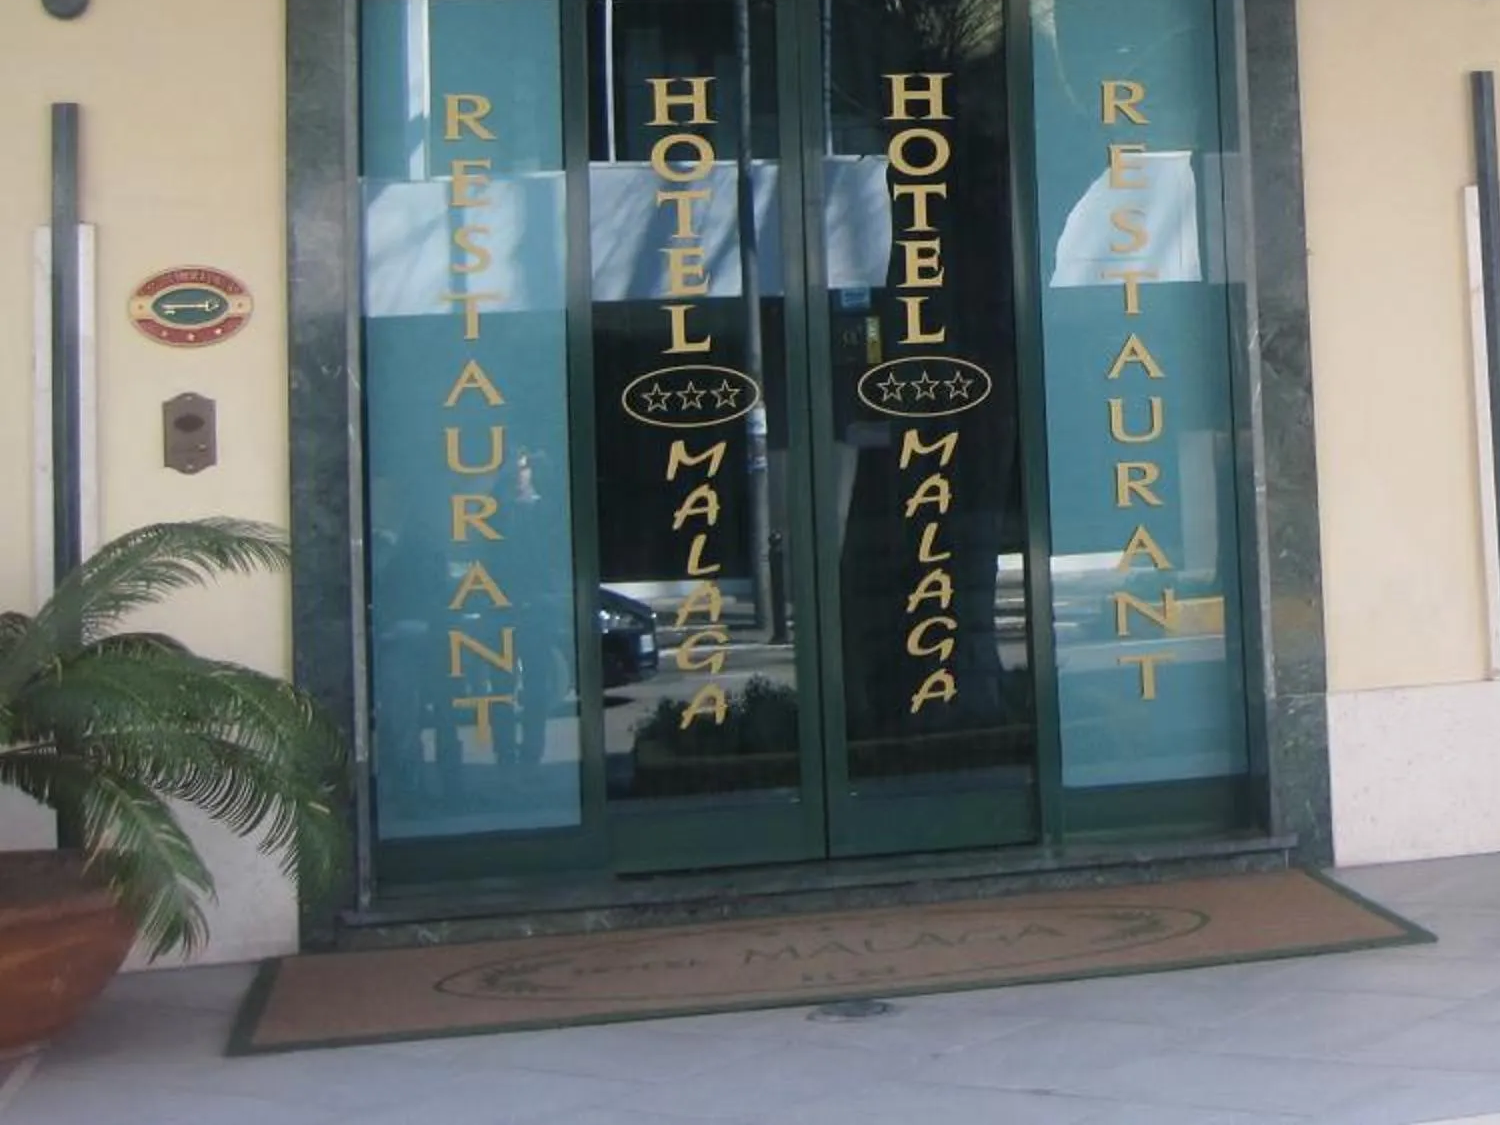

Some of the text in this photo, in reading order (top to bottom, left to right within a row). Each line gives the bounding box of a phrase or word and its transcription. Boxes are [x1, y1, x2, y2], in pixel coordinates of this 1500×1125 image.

[644, 76, 718, 354] HOTEL
[882, 72, 953, 344] HOTEL
[440, 93, 515, 753] RESTAURANT
[1101, 80, 1174, 701] RESTAURANT
[665, 439, 730, 730] MALAGA
[899, 428, 960, 715] MALAGA
